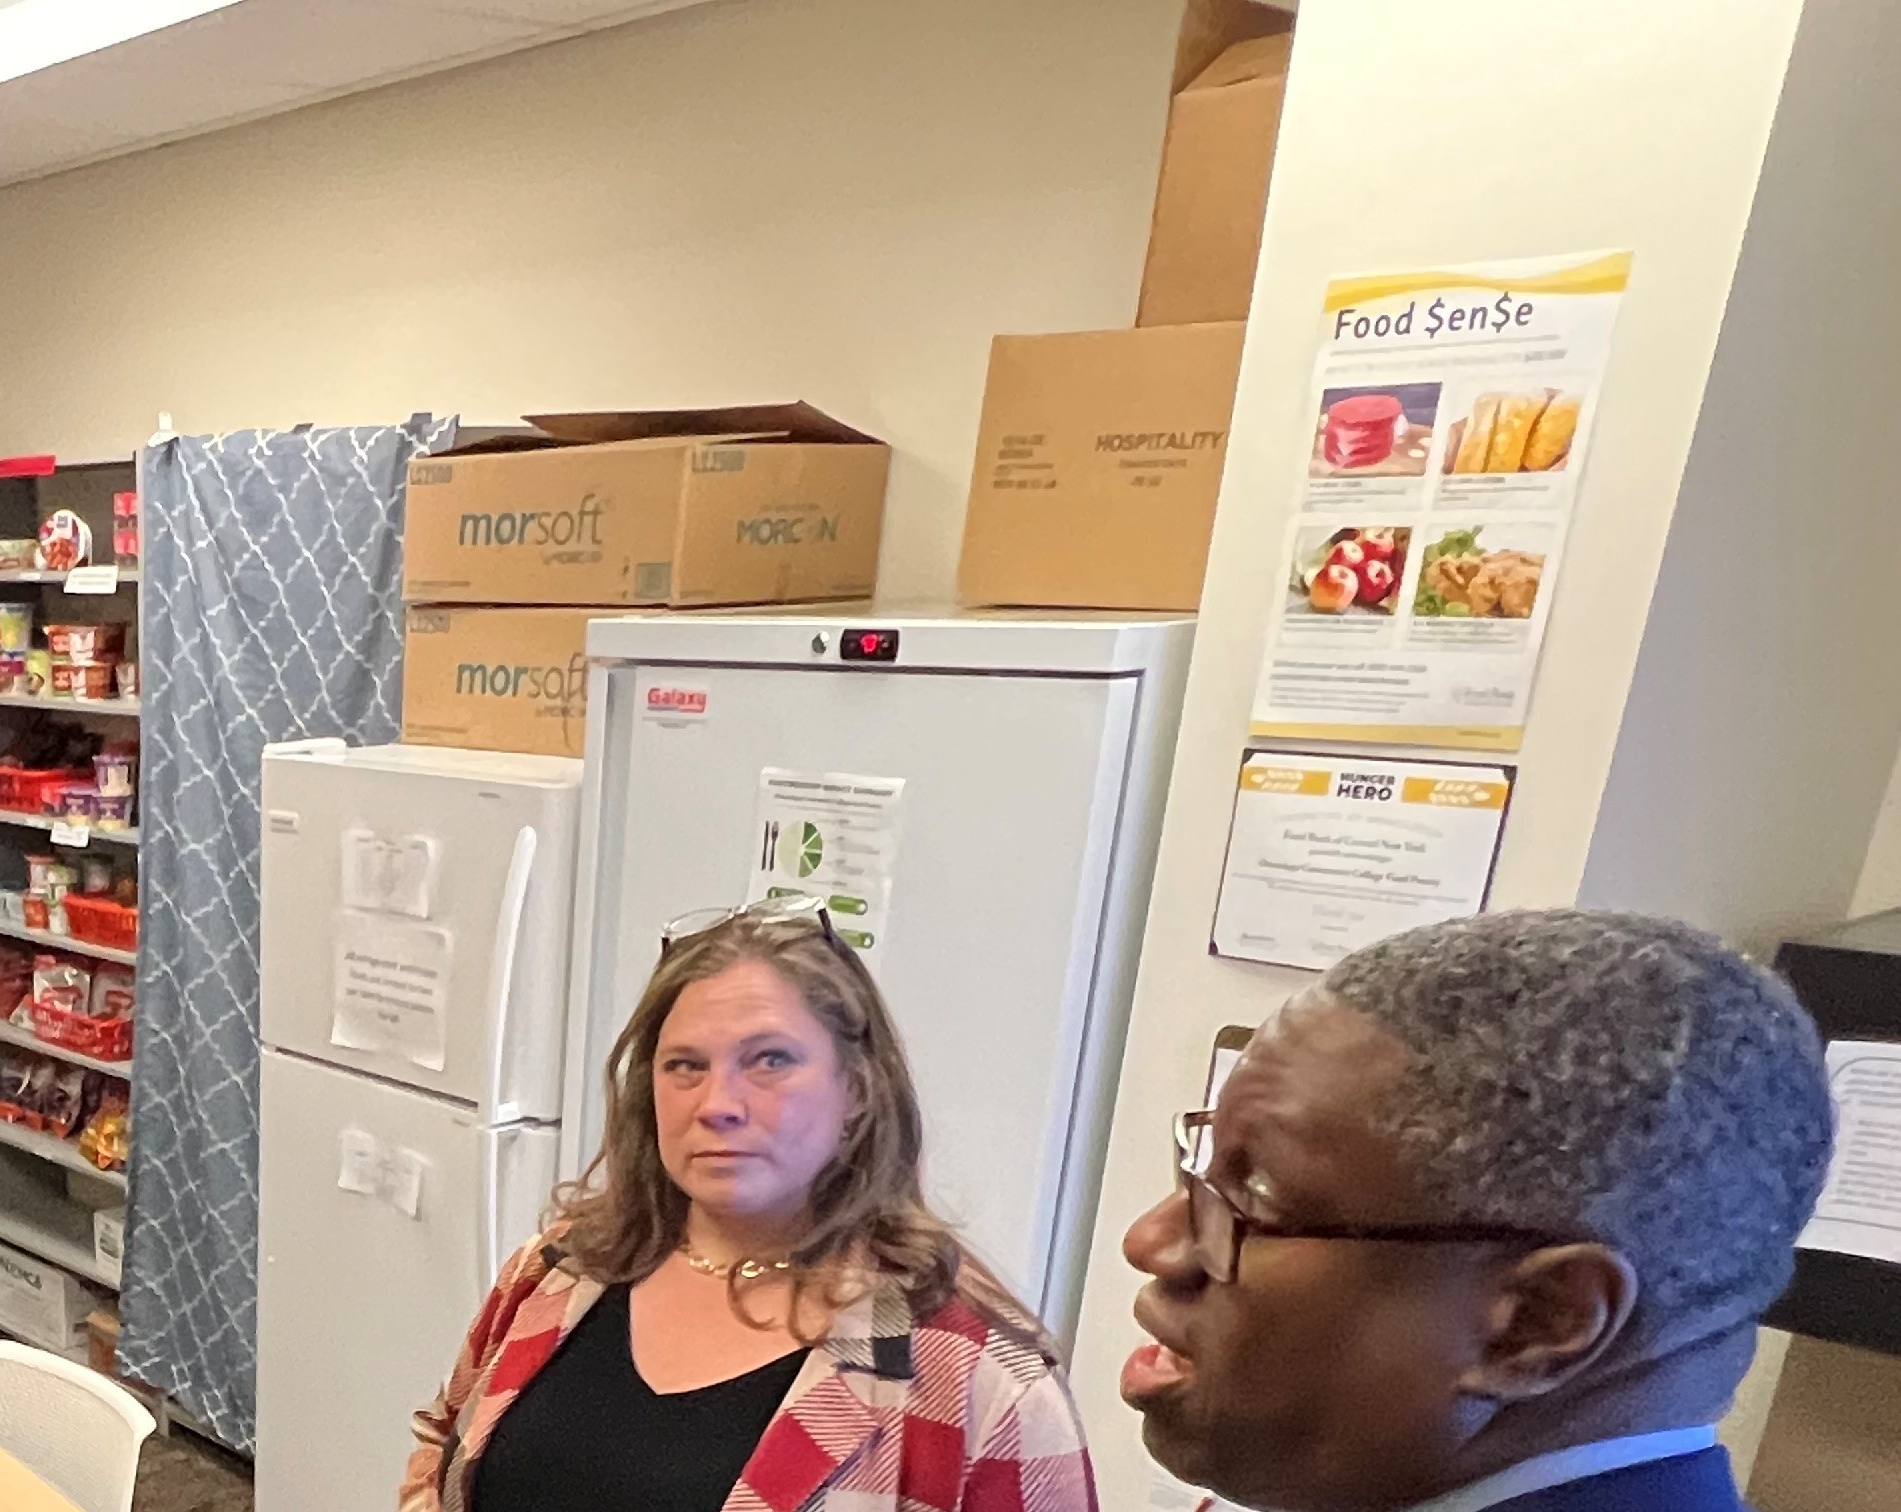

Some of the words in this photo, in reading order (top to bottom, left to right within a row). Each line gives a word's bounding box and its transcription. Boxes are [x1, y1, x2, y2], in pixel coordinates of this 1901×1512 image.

[1334, 301, 1416, 340] Food
[1424, 291, 1534, 339] $en$e
[1094, 431, 1226, 453] HOSPITALITY
[459, 493, 603, 546] morsoft
[647, 687, 707, 711] Galaxy
[1337, 784, 1393, 801] HERO
